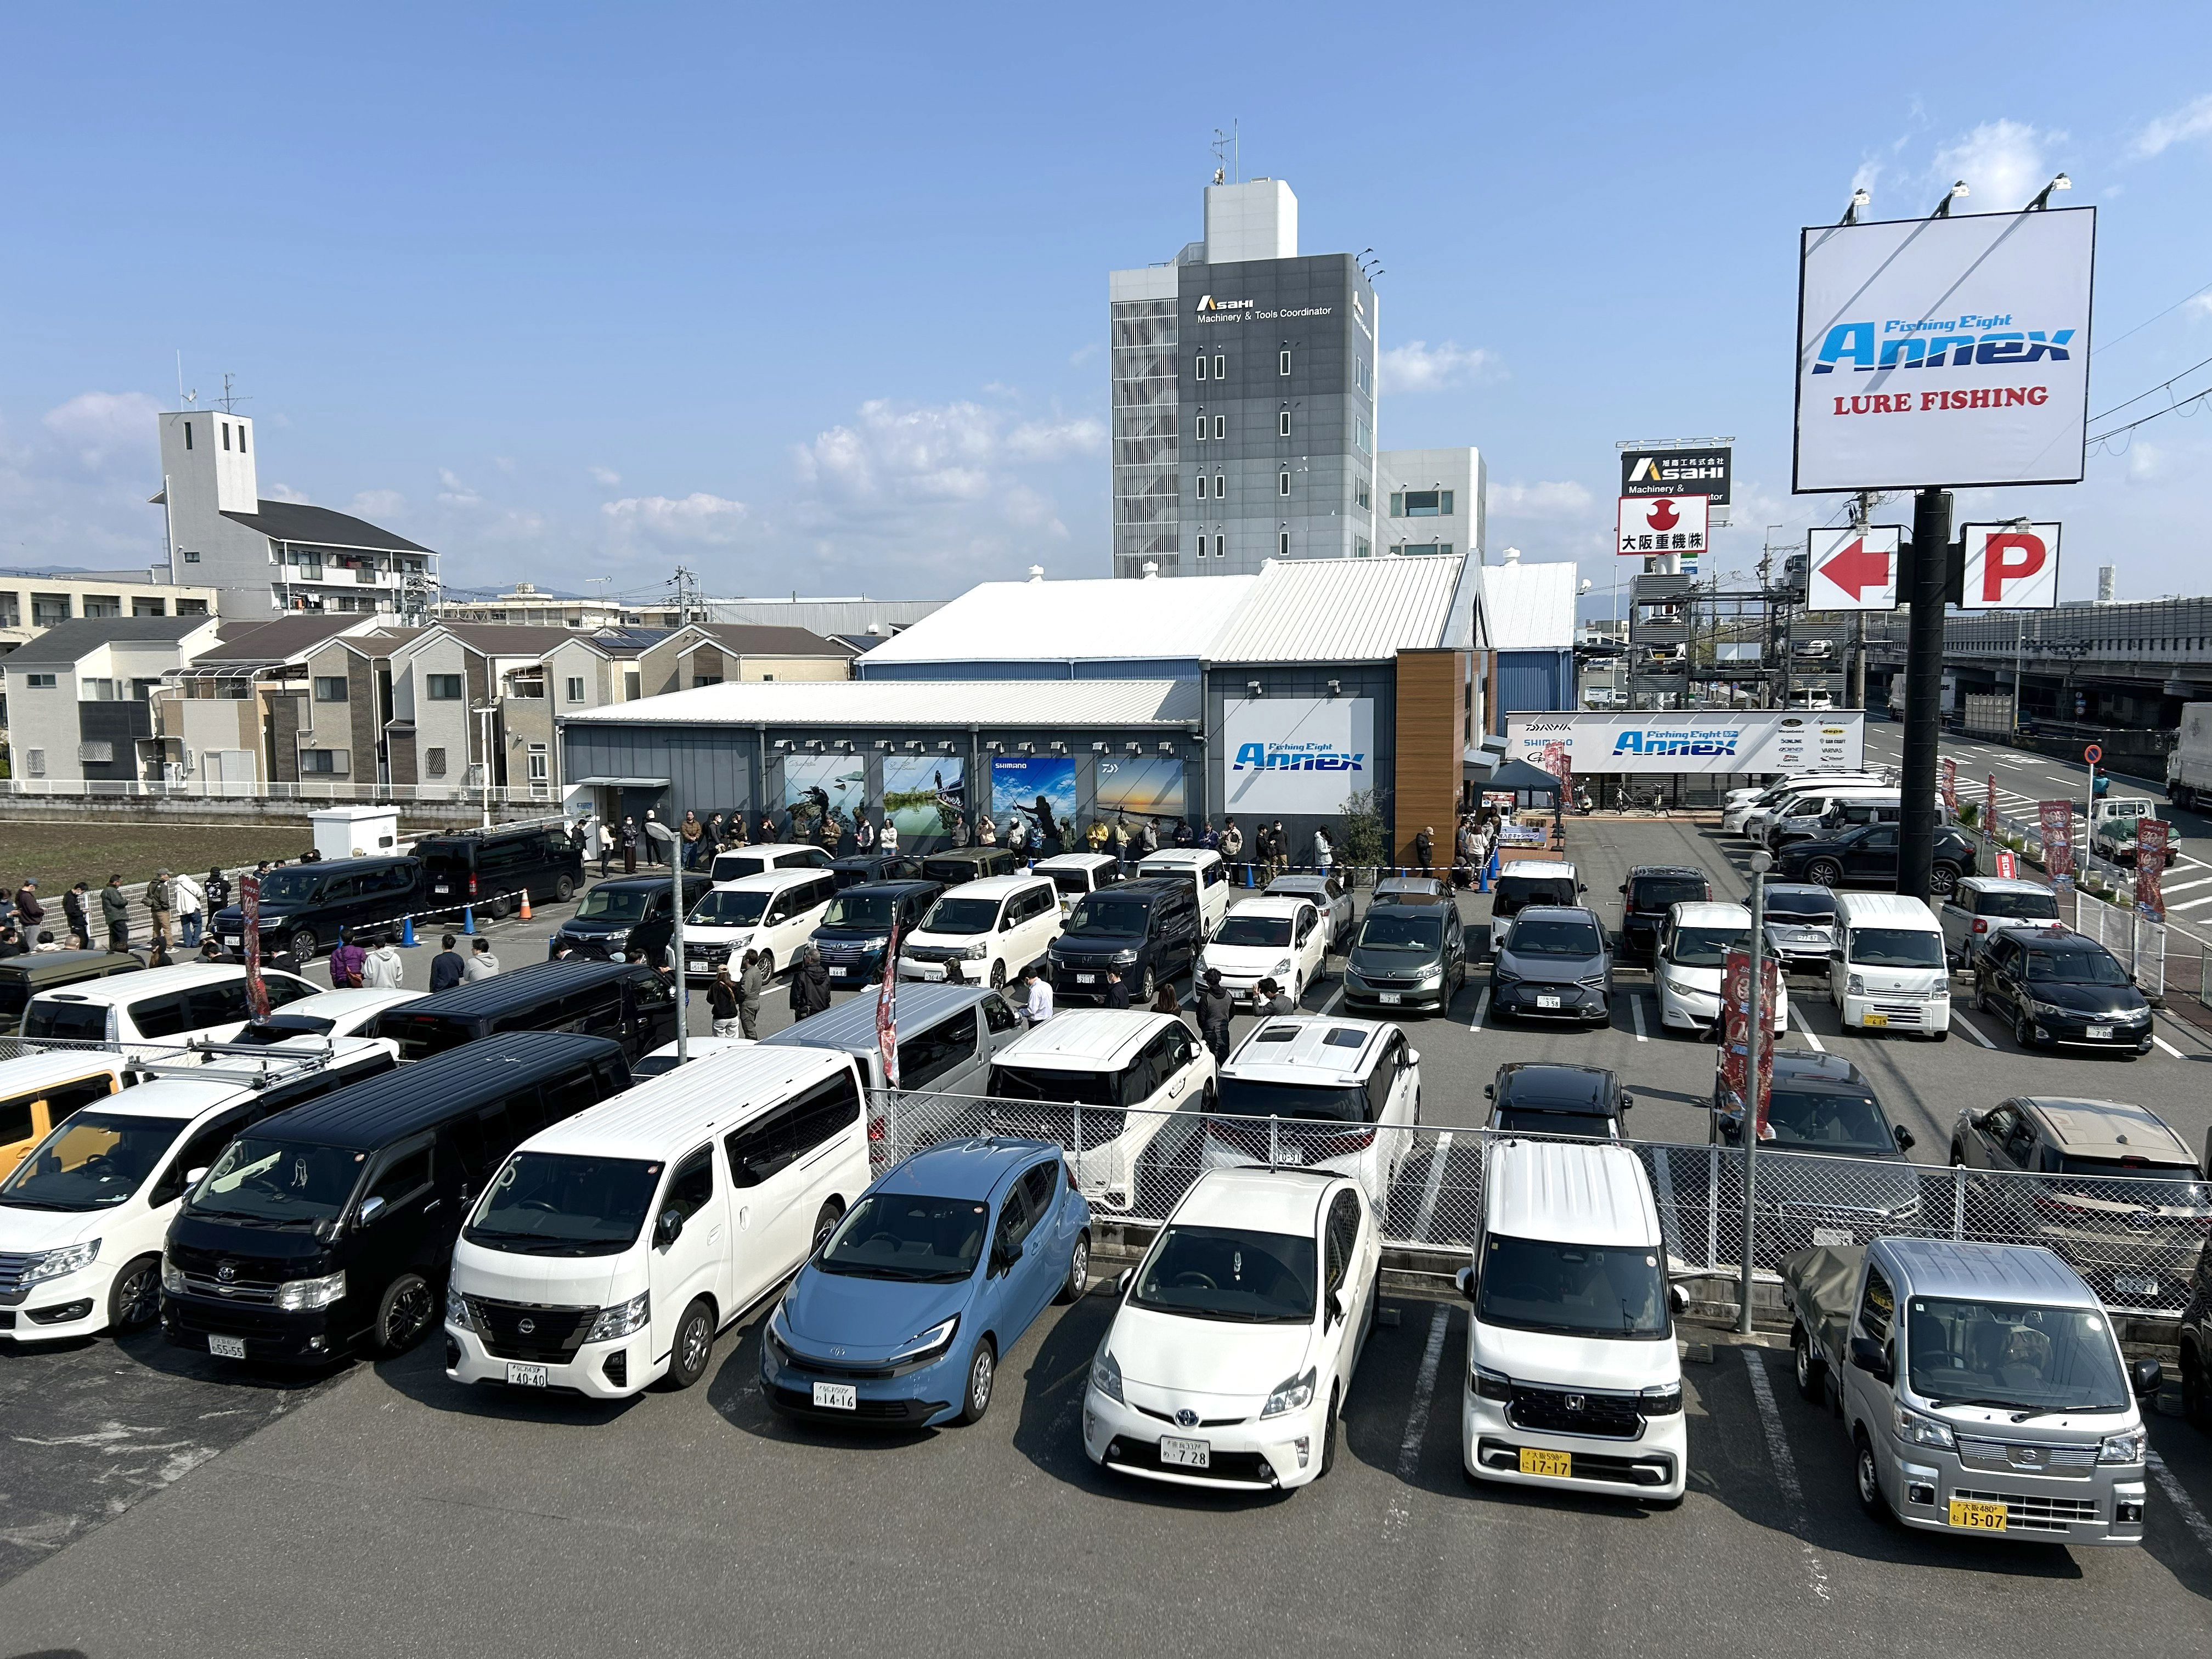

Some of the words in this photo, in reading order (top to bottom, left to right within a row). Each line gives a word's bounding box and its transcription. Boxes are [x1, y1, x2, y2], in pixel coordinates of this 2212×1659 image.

[1198, 313, 1242, 324] Machinery
[1245, 312, 1251, 320] &
[1255, 310, 1278, 319] Tools
[1280, 307, 1332, 318] Coordinator
[1884, 318, 1955, 333] Fishing
[1959, 314, 2013, 331] Eight
[1811, 321, 2076, 374] Annex
[1833, 393, 1911, 415] LURE
[1920, 386, 2049, 411] FISHING
[1629, 486, 1674, 494] Machinery
[1982, 533, 2046, 602] P
[1612, 731, 1738, 755] Annex
[1647, 731, 1688, 739] Fishing
[1690, 731, 1722, 739] Eight
[1268, 743, 1304, 752] Fishing
[1306, 743, 1333, 752] Eight
[1233, 743, 1365, 771] Annex
[217, 1344, 242, 1357] 55-55
[516, 1373, 544, 1386] 40-40
[824, 1393, 853, 1407] 14-16
[1533, 1459, 1568, 1475] 17-17
[1963, 1511, 2003, 1528] 15-07
